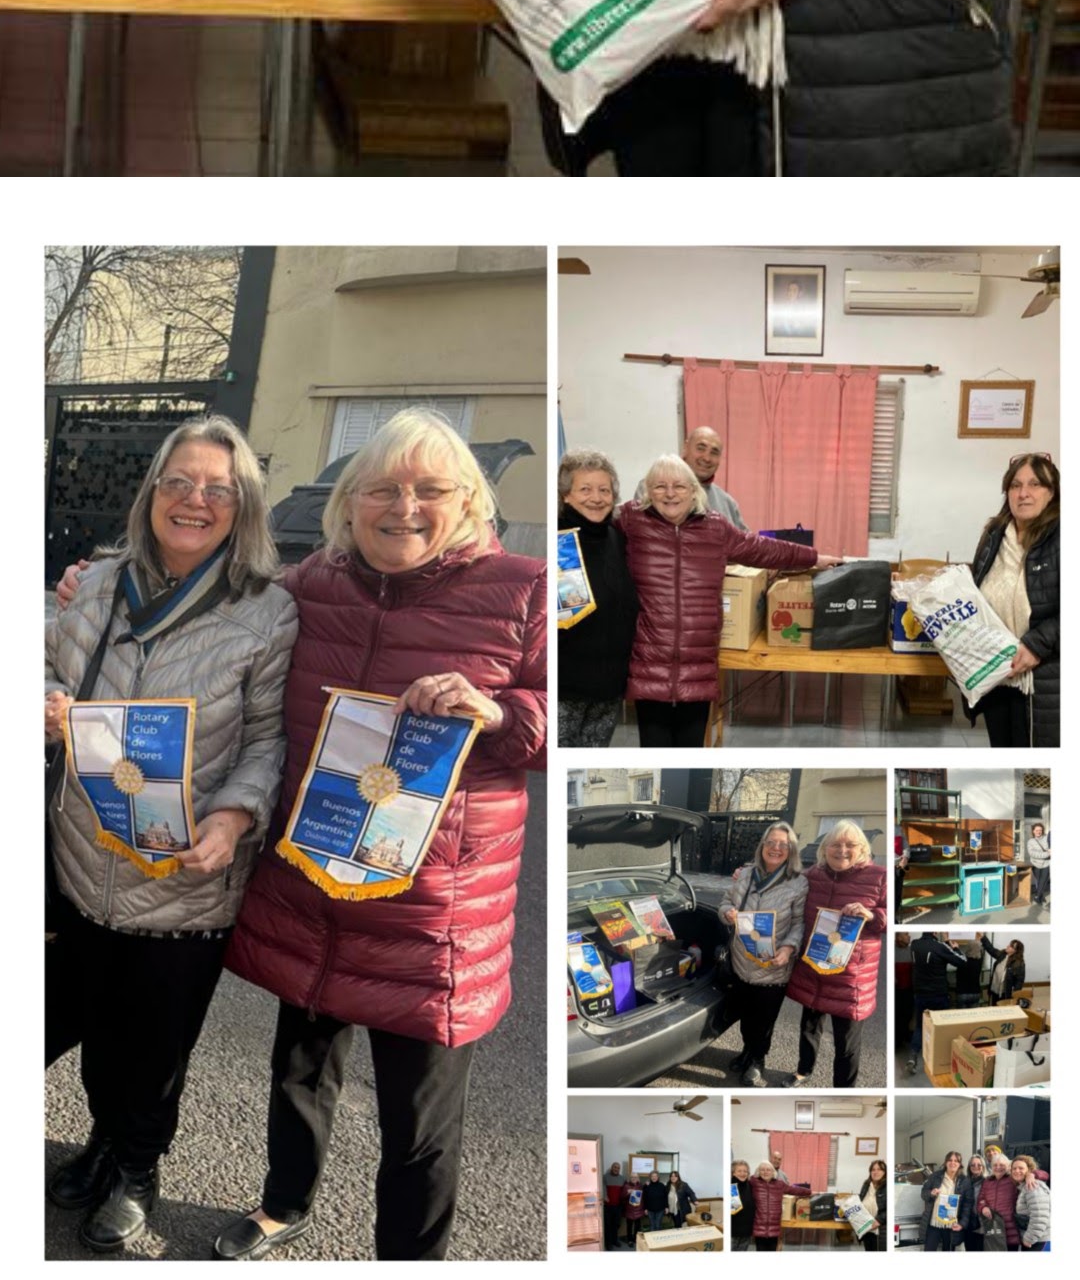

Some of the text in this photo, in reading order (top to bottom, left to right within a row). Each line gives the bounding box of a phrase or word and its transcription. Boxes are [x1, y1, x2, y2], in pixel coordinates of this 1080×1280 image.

[133, 712, 169, 724] Rotary
[407, 716, 449, 733] Rotary
[133, 725, 158, 735] Club
[131, 738, 146, 747] de
[403, 730, 432, 745] Club
[131, 750, 162, 761] Flores
[400, 744, 415, 756] de
[395, 757, 429, 773] Flores
[322, 799, 361, 818] Buenos
[331, 814, 357, 828] Aires
[302, 818, 353, 839] Argentina
